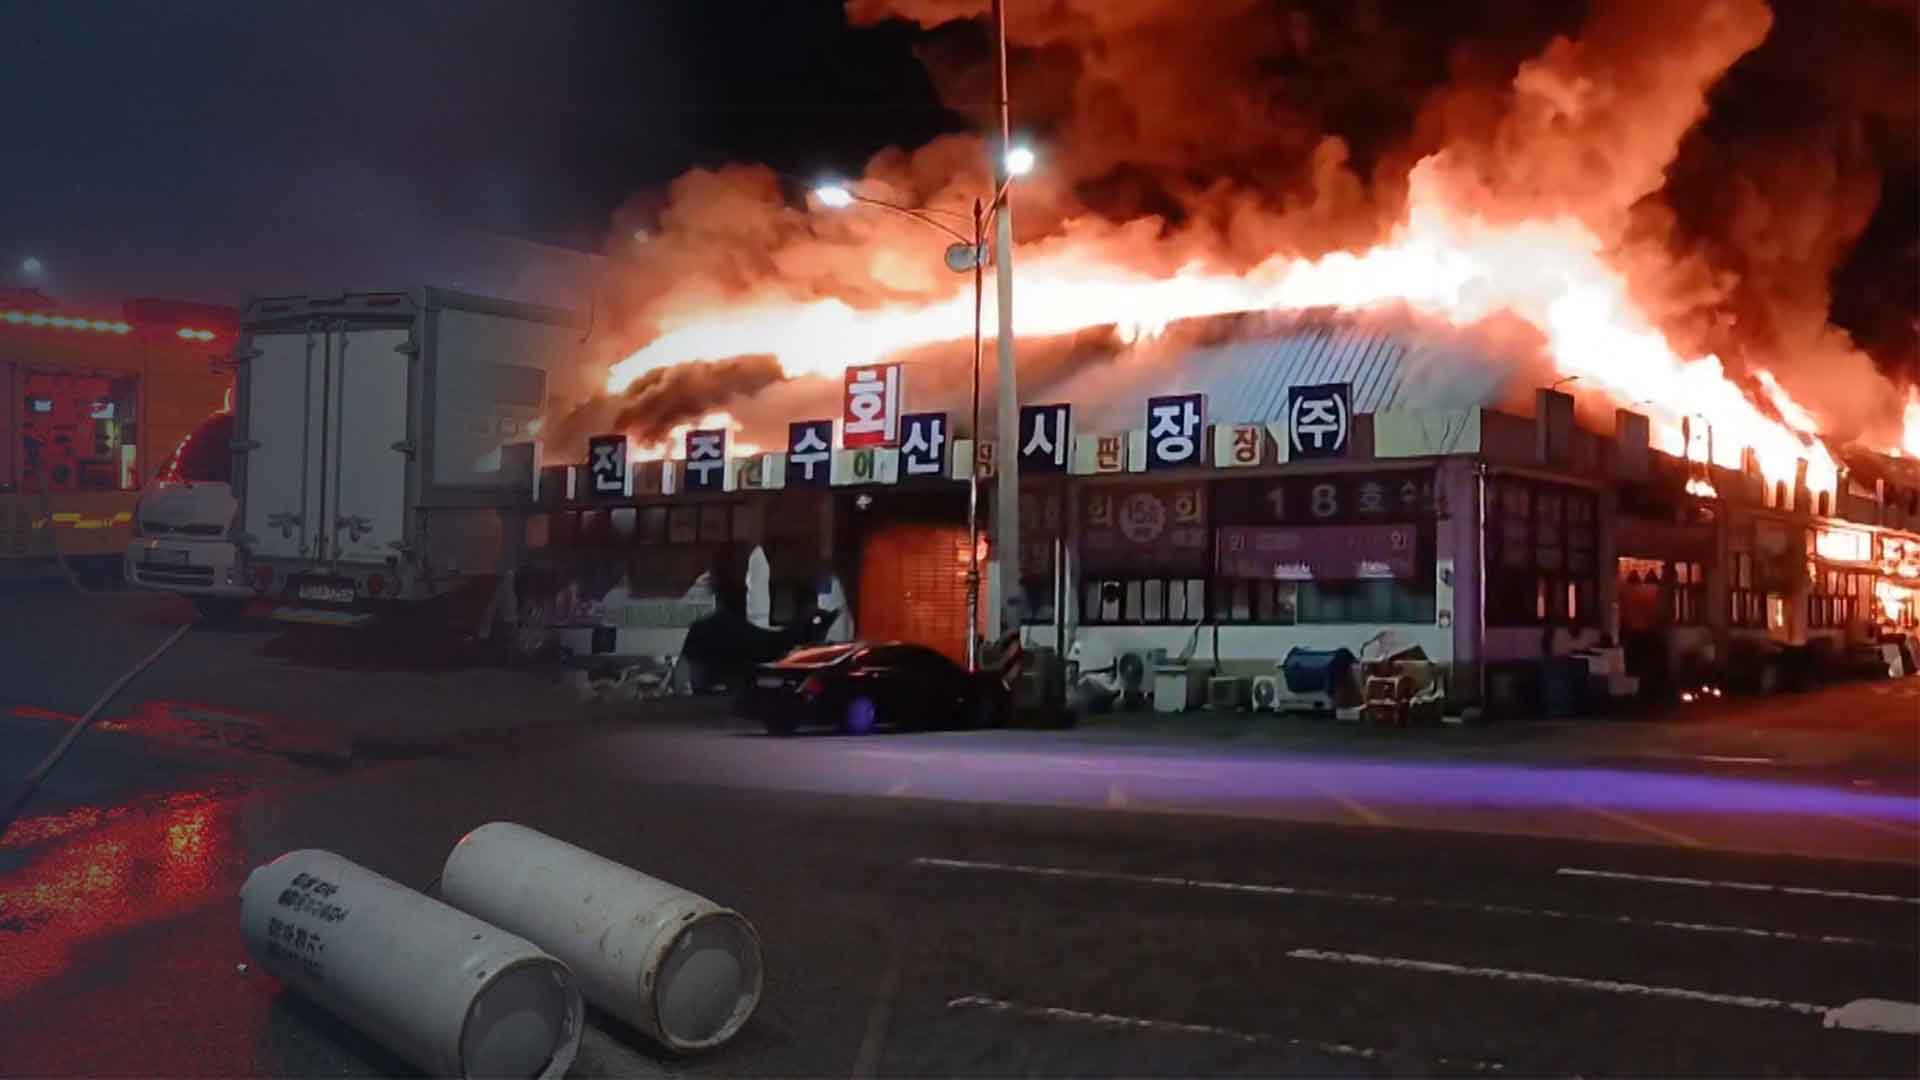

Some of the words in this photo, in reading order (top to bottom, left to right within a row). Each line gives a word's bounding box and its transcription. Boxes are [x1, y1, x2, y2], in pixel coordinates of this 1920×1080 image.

[846, 366, 897, 440] 회
[593, 442, 625, 491] 전
[687, 436, 723, 485] 주
[790, 427, 829, 480] 수
[902, 420, 944, 475] 산
[1023, 408, 1064, 465] 시
[1150, 402, 1199, 462] 장
[1291, 393, 1346, 451] (주)
[1098, 438, 1119, 470] 판
[1234, 428, 1256, 462] 장
